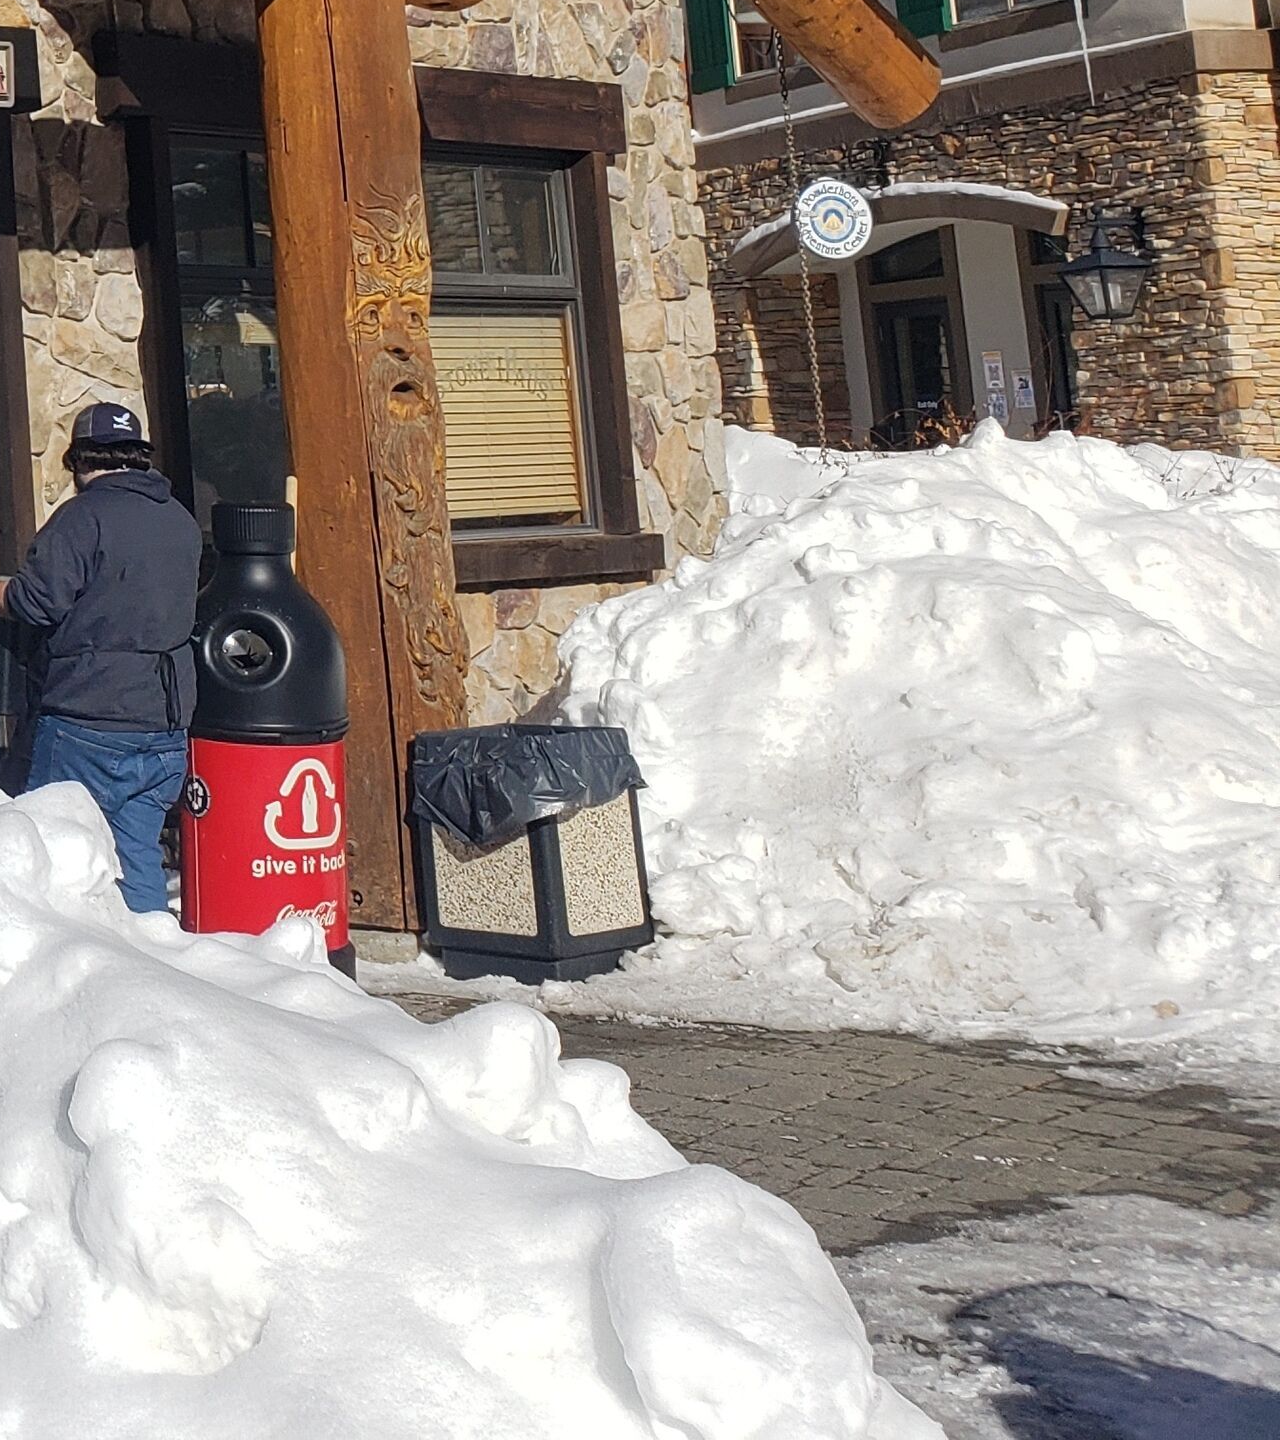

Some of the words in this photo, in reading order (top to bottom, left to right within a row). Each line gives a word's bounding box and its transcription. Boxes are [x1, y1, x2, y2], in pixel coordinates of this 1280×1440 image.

[844, 221, 868, 251] Center
[252, 855, 297, 877] give
[302, 855, 316, 874] it
